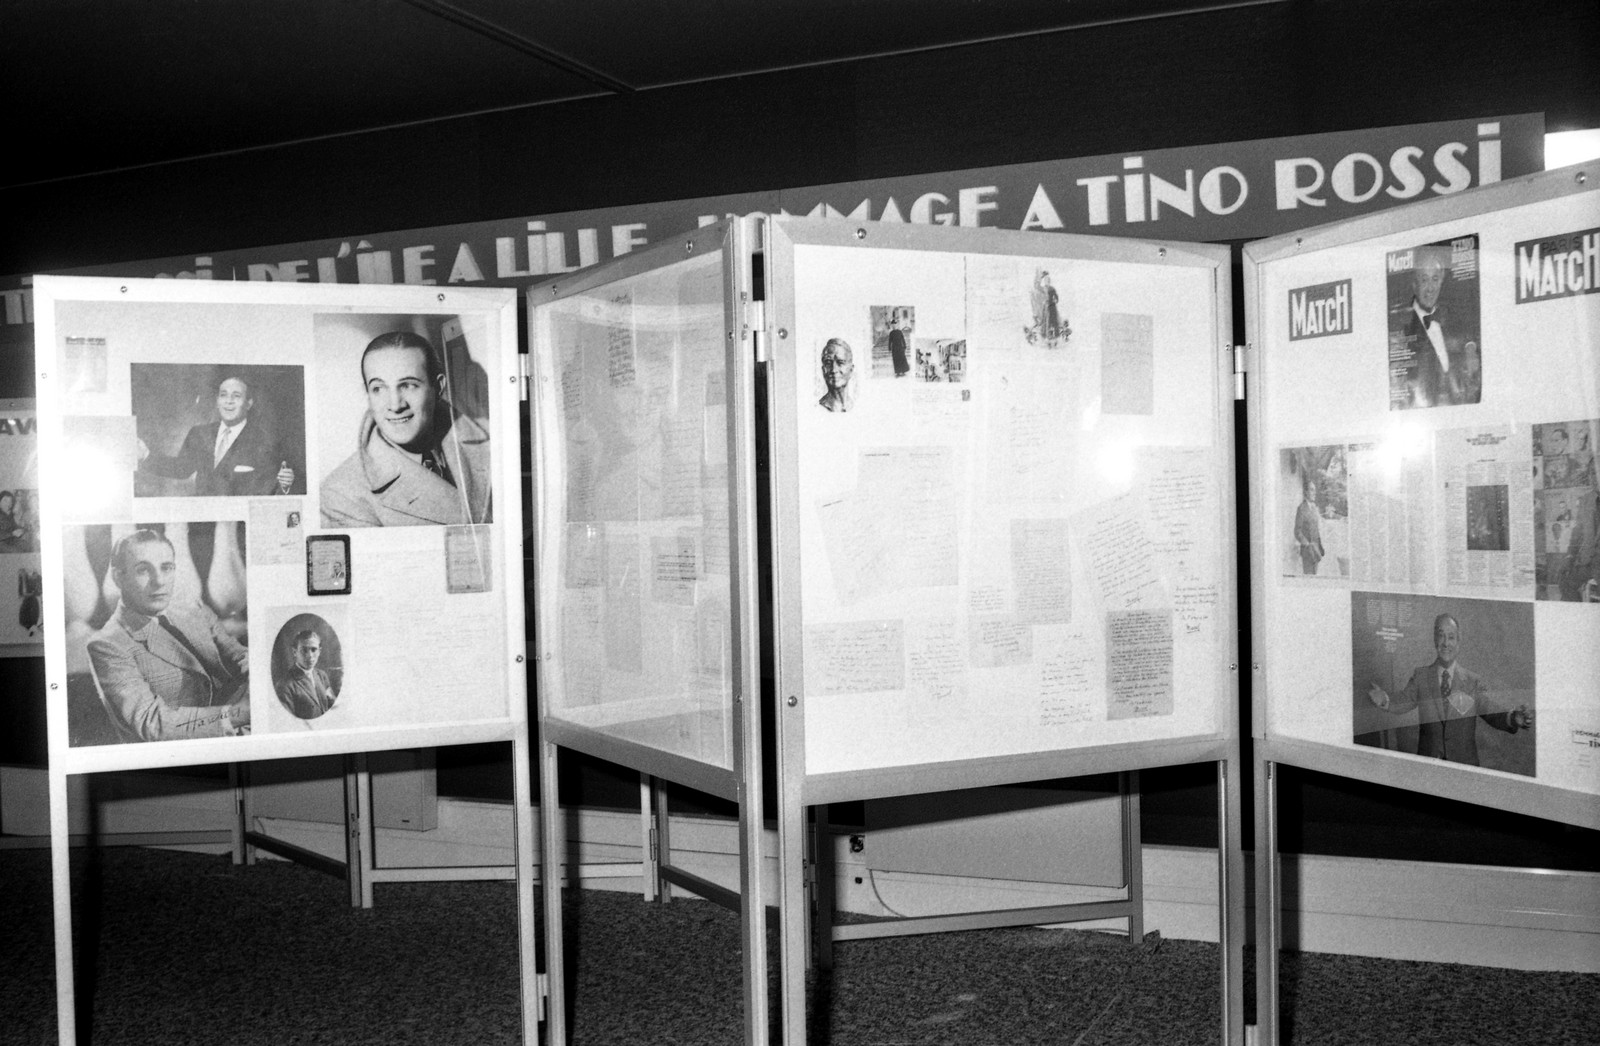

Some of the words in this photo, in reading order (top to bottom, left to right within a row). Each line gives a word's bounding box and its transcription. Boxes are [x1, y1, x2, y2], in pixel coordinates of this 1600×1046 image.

[448, 242, 485, 283] A
[1020, 183, 1064, 230] A
[1520, 232, 1600, 300] MATCH
[1292, 283, 1349, 338] MATCH
